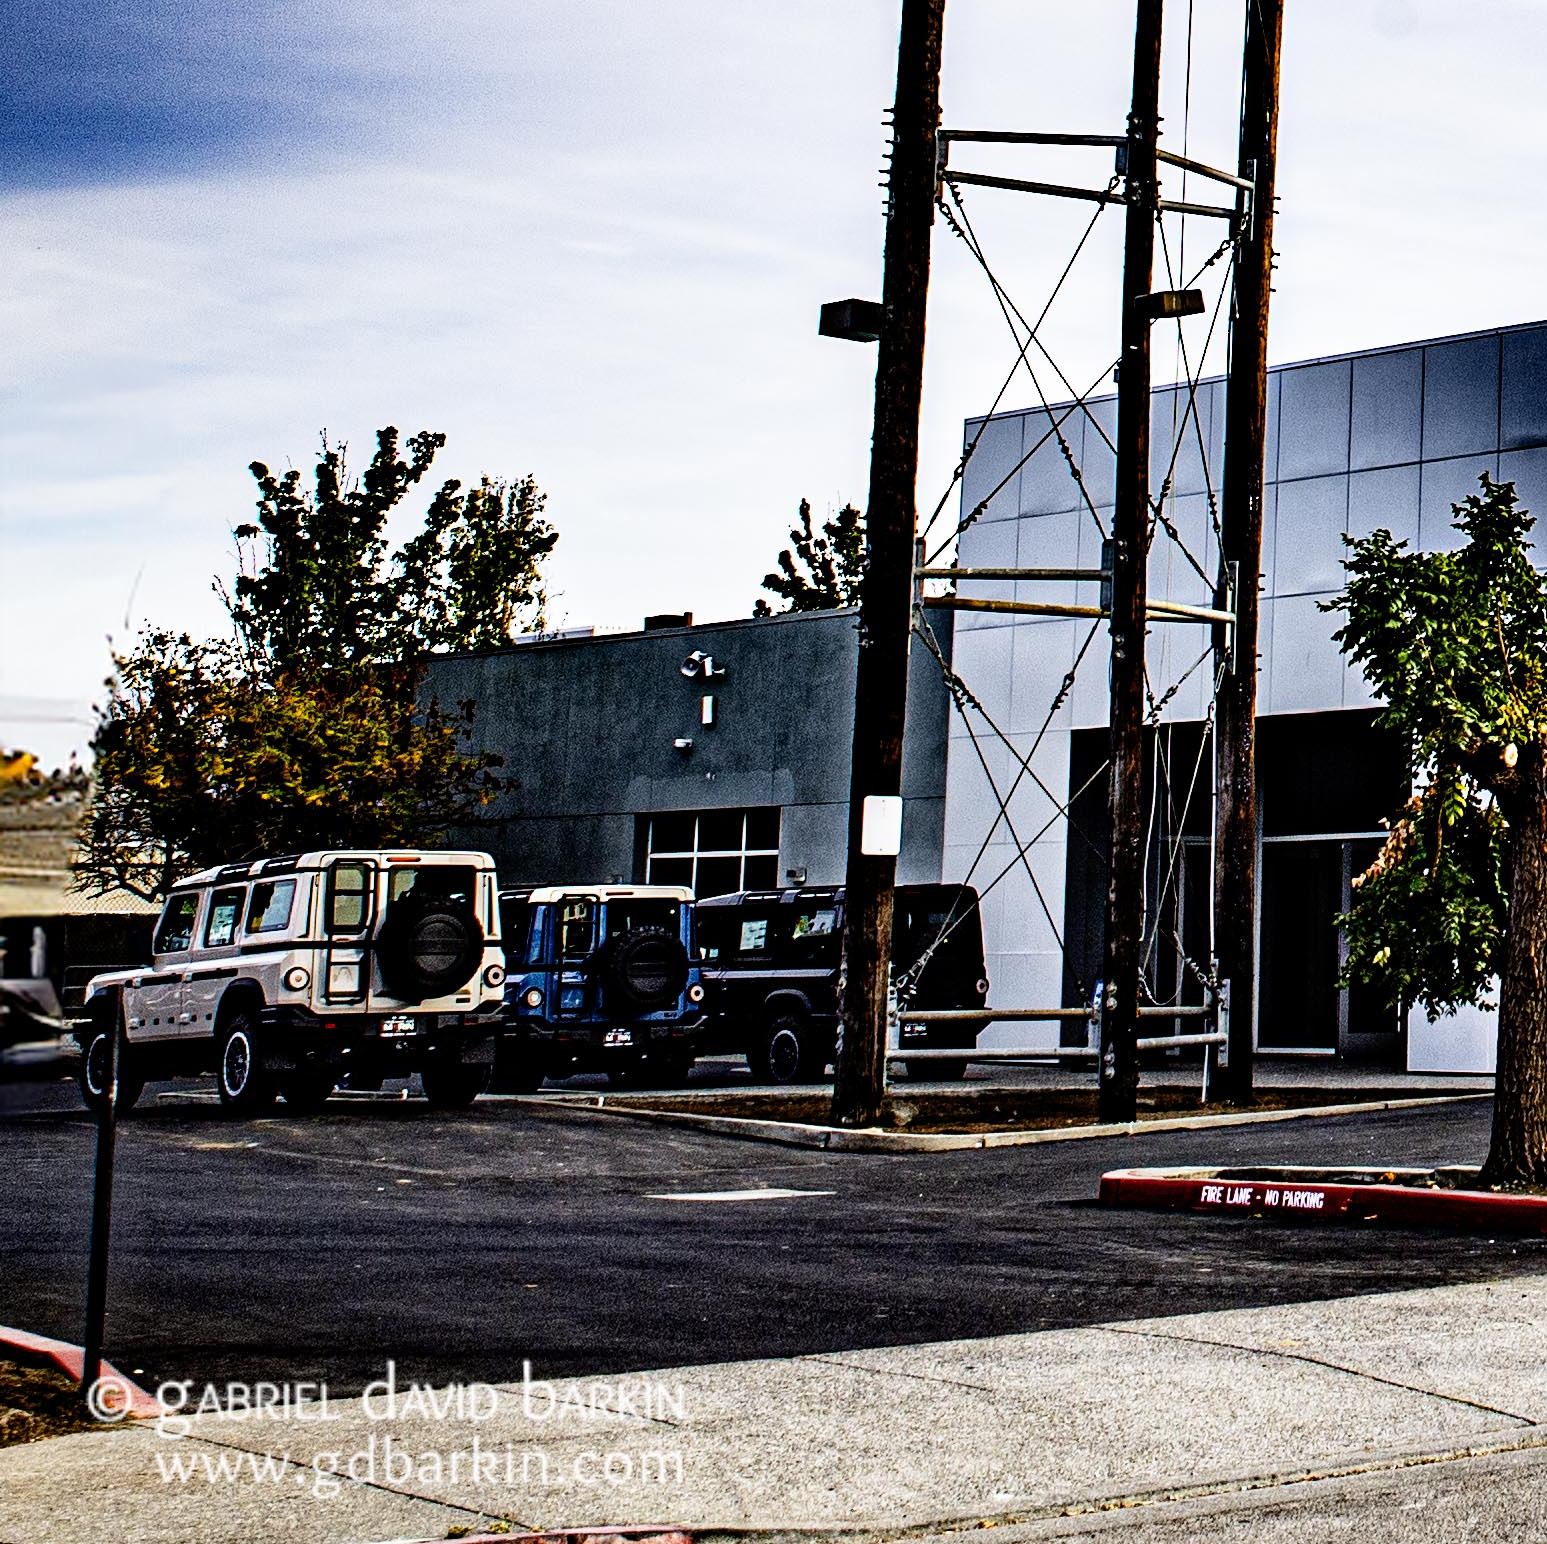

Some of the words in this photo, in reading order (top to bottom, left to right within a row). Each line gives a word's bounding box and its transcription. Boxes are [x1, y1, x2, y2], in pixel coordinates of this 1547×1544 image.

[1200, 1185, 1225, 1204] FIRE
[1226, 1186, 1253, 1206] LANE
[1264, 1188, 1280, 1206] NO
[1281, 1190, 1326, 1209] PARKING
